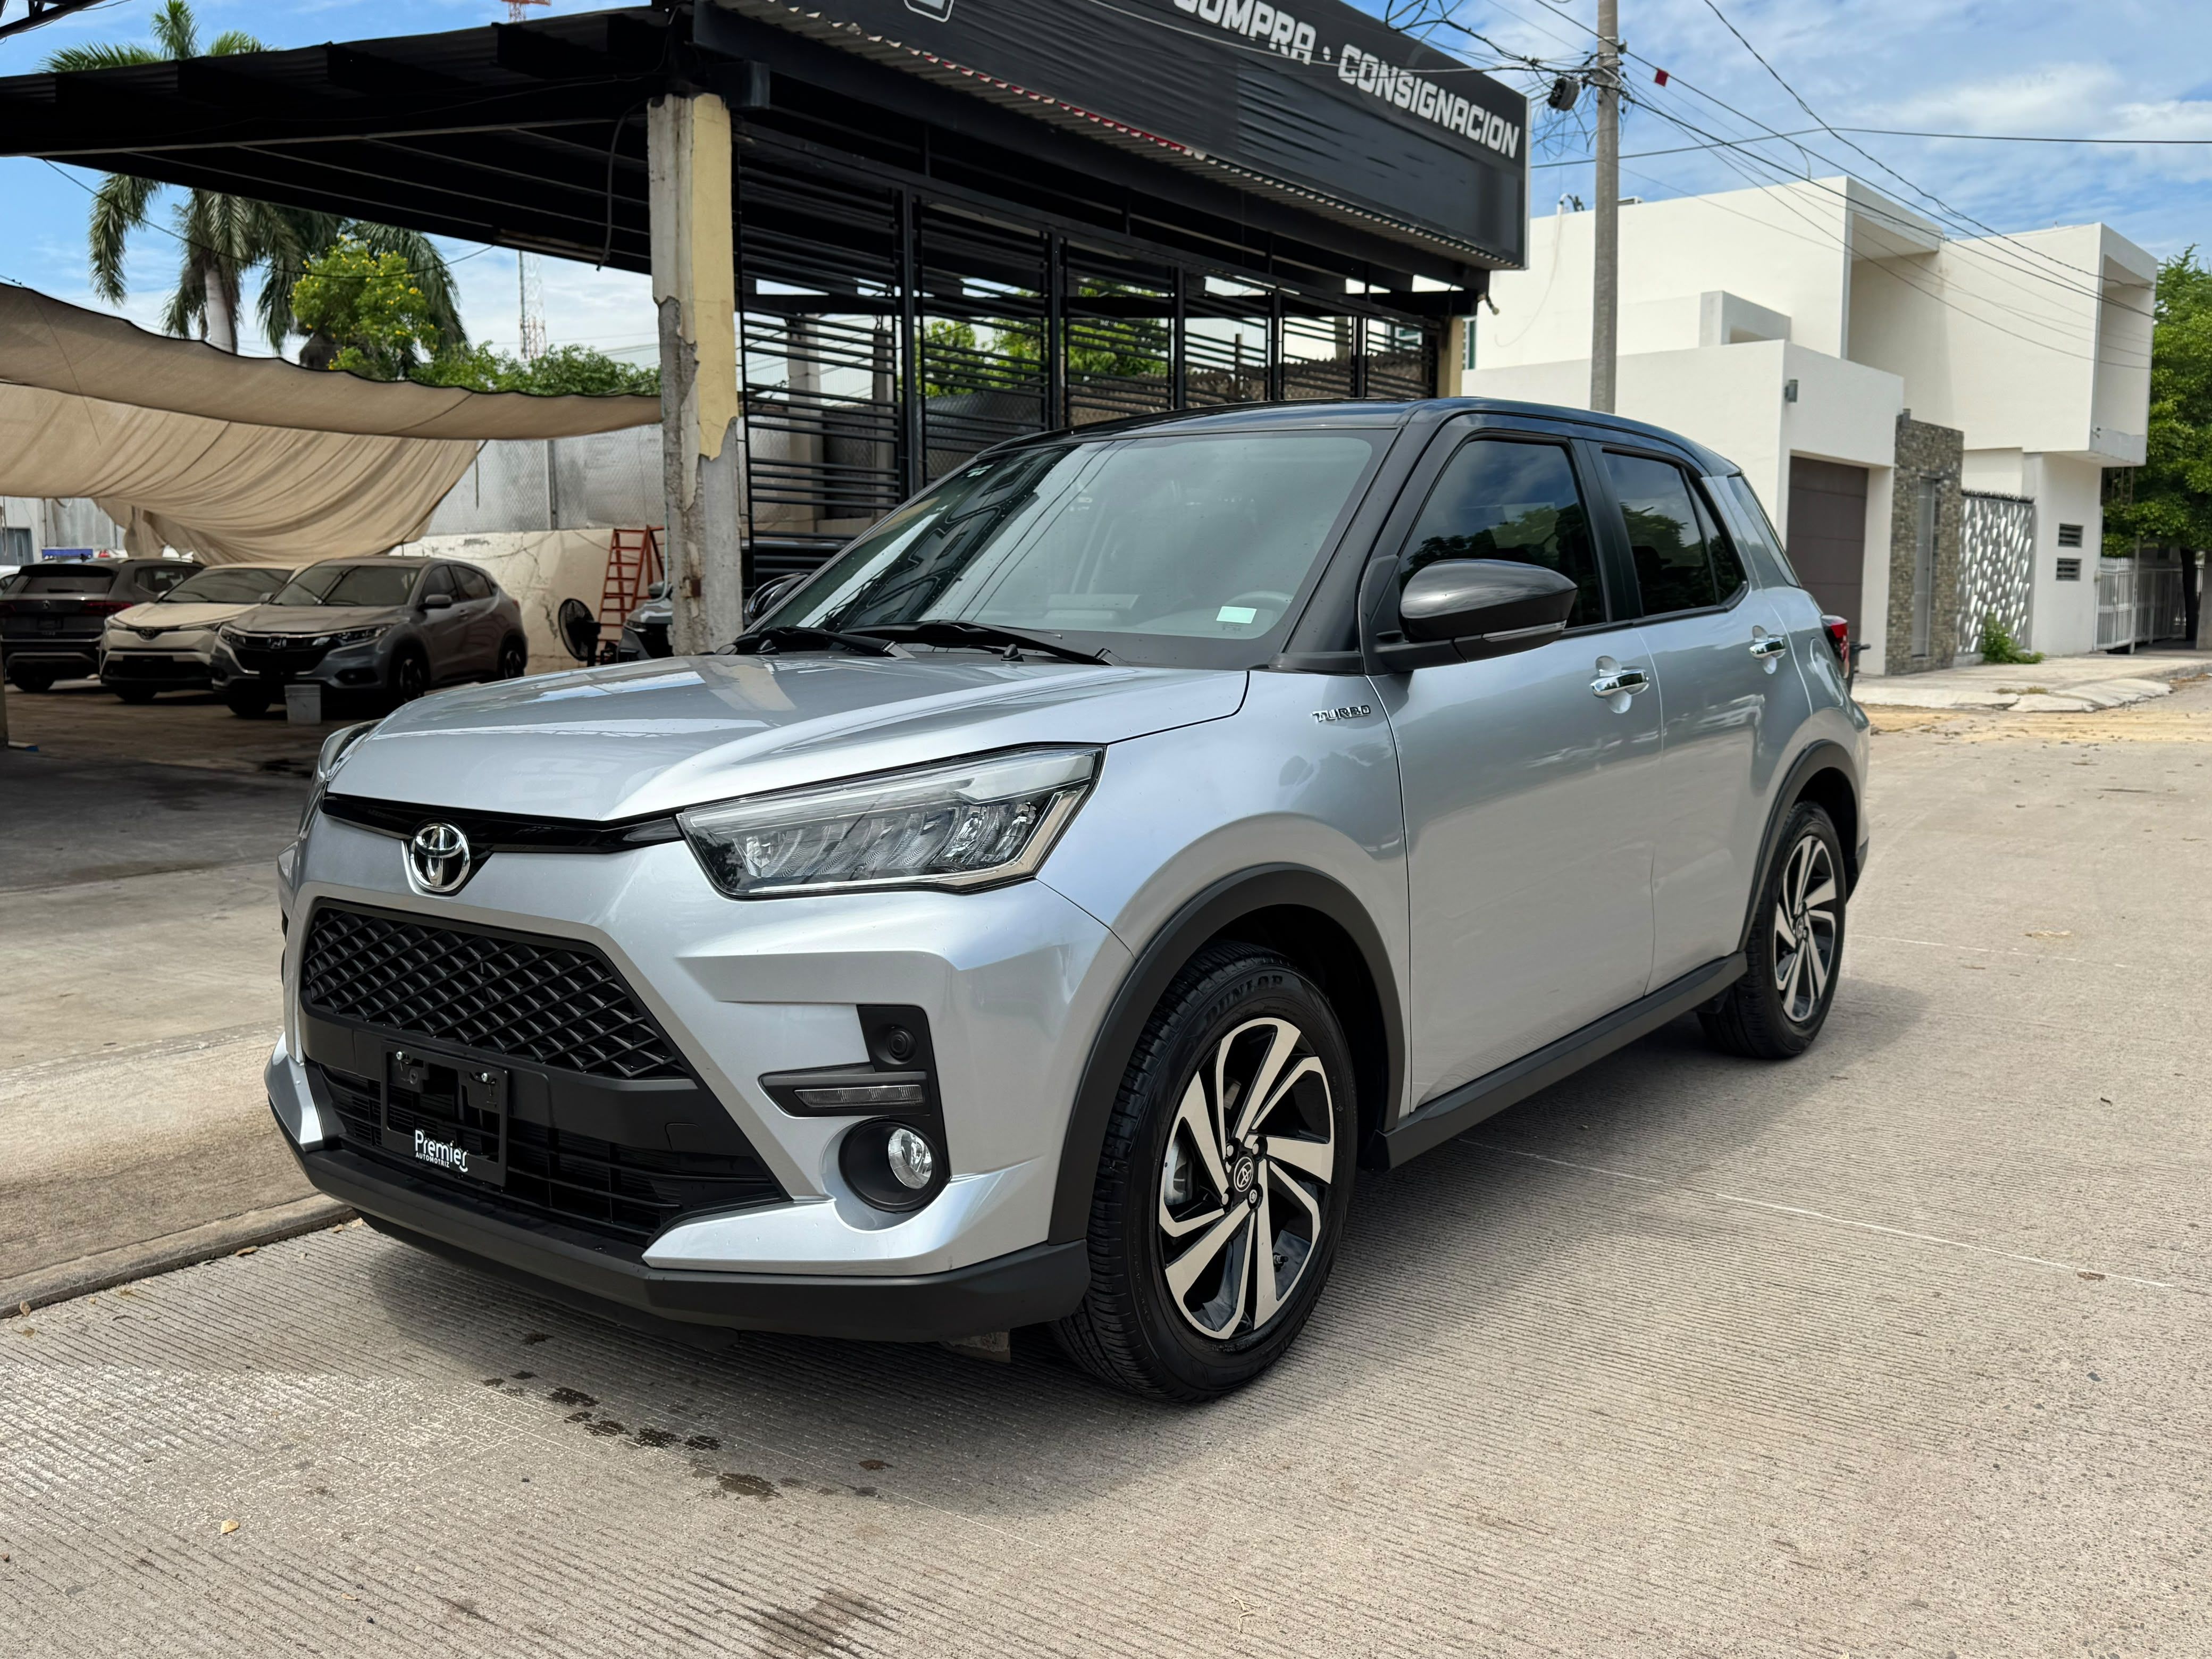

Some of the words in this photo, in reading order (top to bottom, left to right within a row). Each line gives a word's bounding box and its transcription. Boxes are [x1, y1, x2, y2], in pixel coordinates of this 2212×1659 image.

[1338, 44, 1520, 158] CONSIGNACION
[1311, 705, 1371, 723] TURBO
[1205, 975, 1283, 1025] DUNLOP
[415, 1129, 468, 1172] Premier
[415, 1151, 450, 1168] AUTOMOTRIZ
